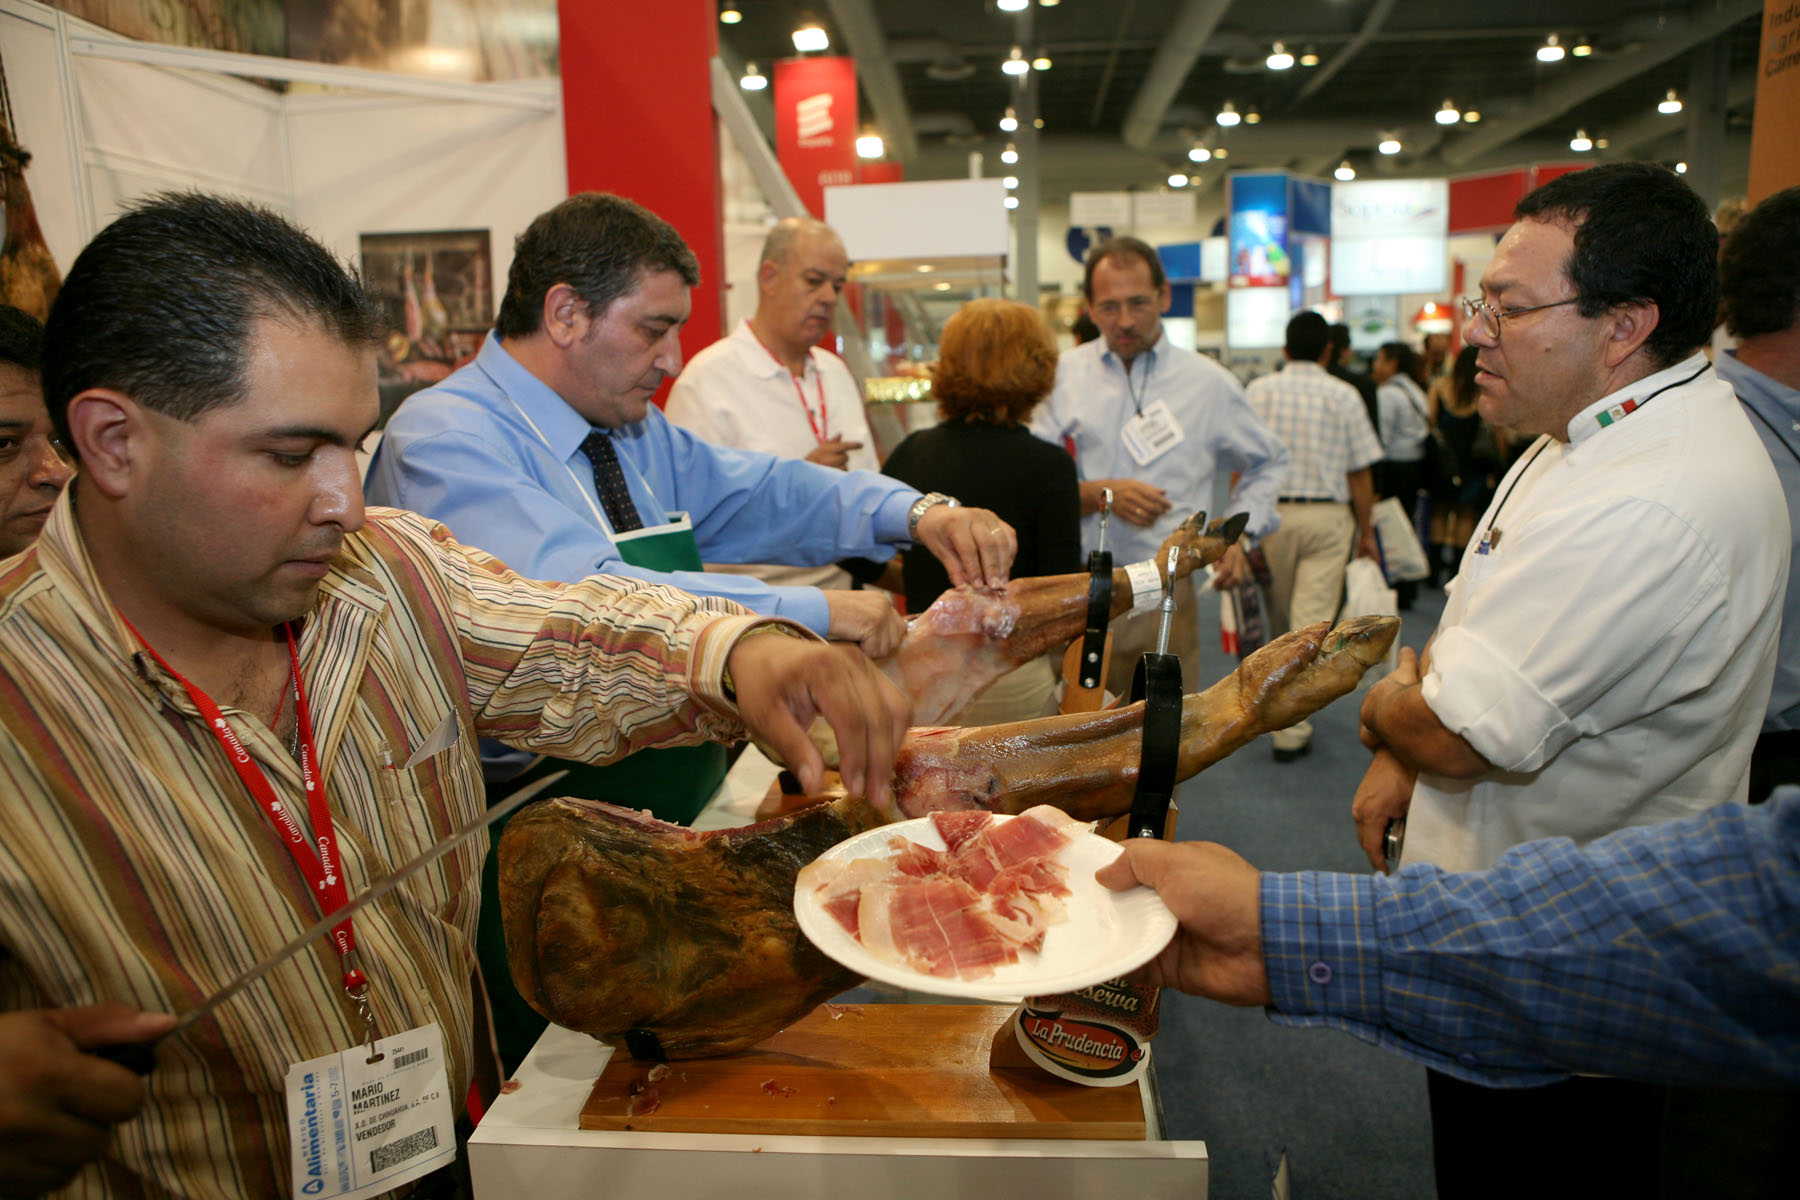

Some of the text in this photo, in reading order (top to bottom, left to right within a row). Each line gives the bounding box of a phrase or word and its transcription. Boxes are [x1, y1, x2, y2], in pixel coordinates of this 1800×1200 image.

[223, 727, 249, 763] Canada
[301, 742, 315, 781] Canada
[278, 809, 303, 843] Canada
[318, 836, 335, 875] Canada
[336, 930, 348, 954] Can
[1032, 1020, 1123, 1060] La Prudencia
[352, 1082, 384, 1102] MARIO
[353, 1088, 401, 1113] MARTINEZ
[301, 1072, 322, 1176] Alimentaria
[356, 1118, 396, 1141] VENDEDOR
